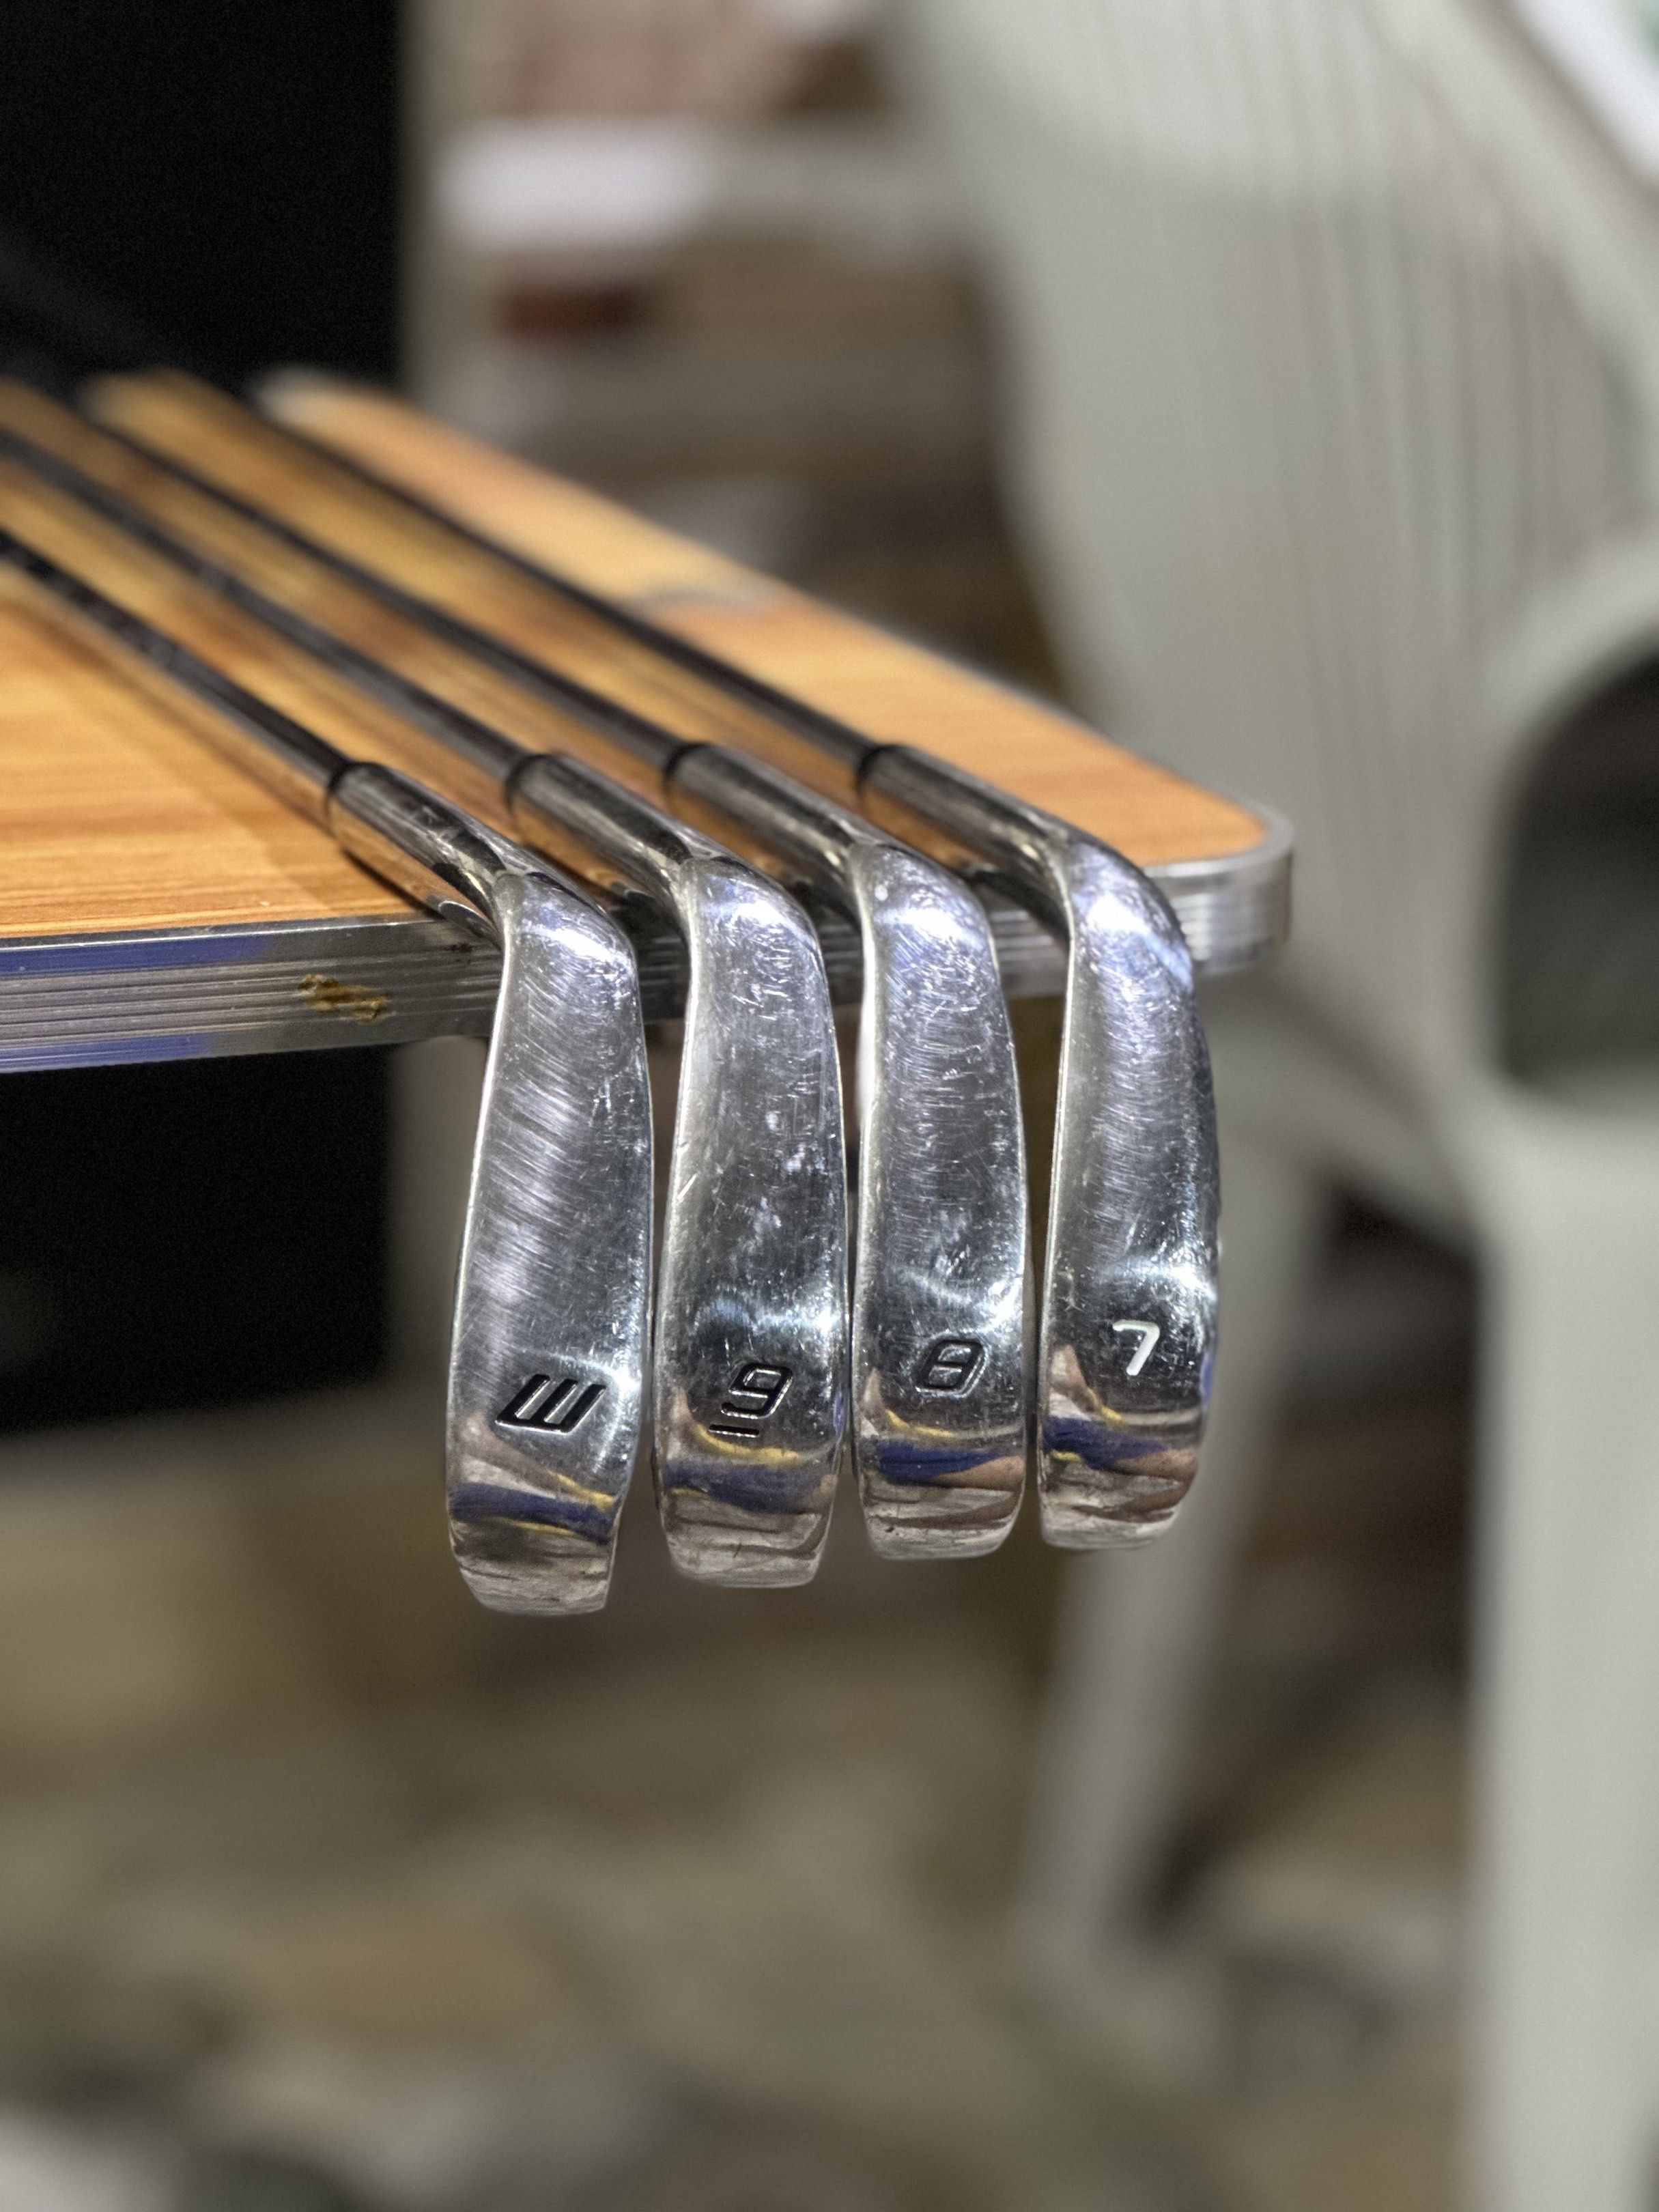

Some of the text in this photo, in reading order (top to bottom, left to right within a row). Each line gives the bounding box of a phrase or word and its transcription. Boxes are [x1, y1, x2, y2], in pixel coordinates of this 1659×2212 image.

[916, 1336, 988, 1397] 8
[1112, 1319, 1160, 1376] 7
[720, 1363, 793, 1420] 9
